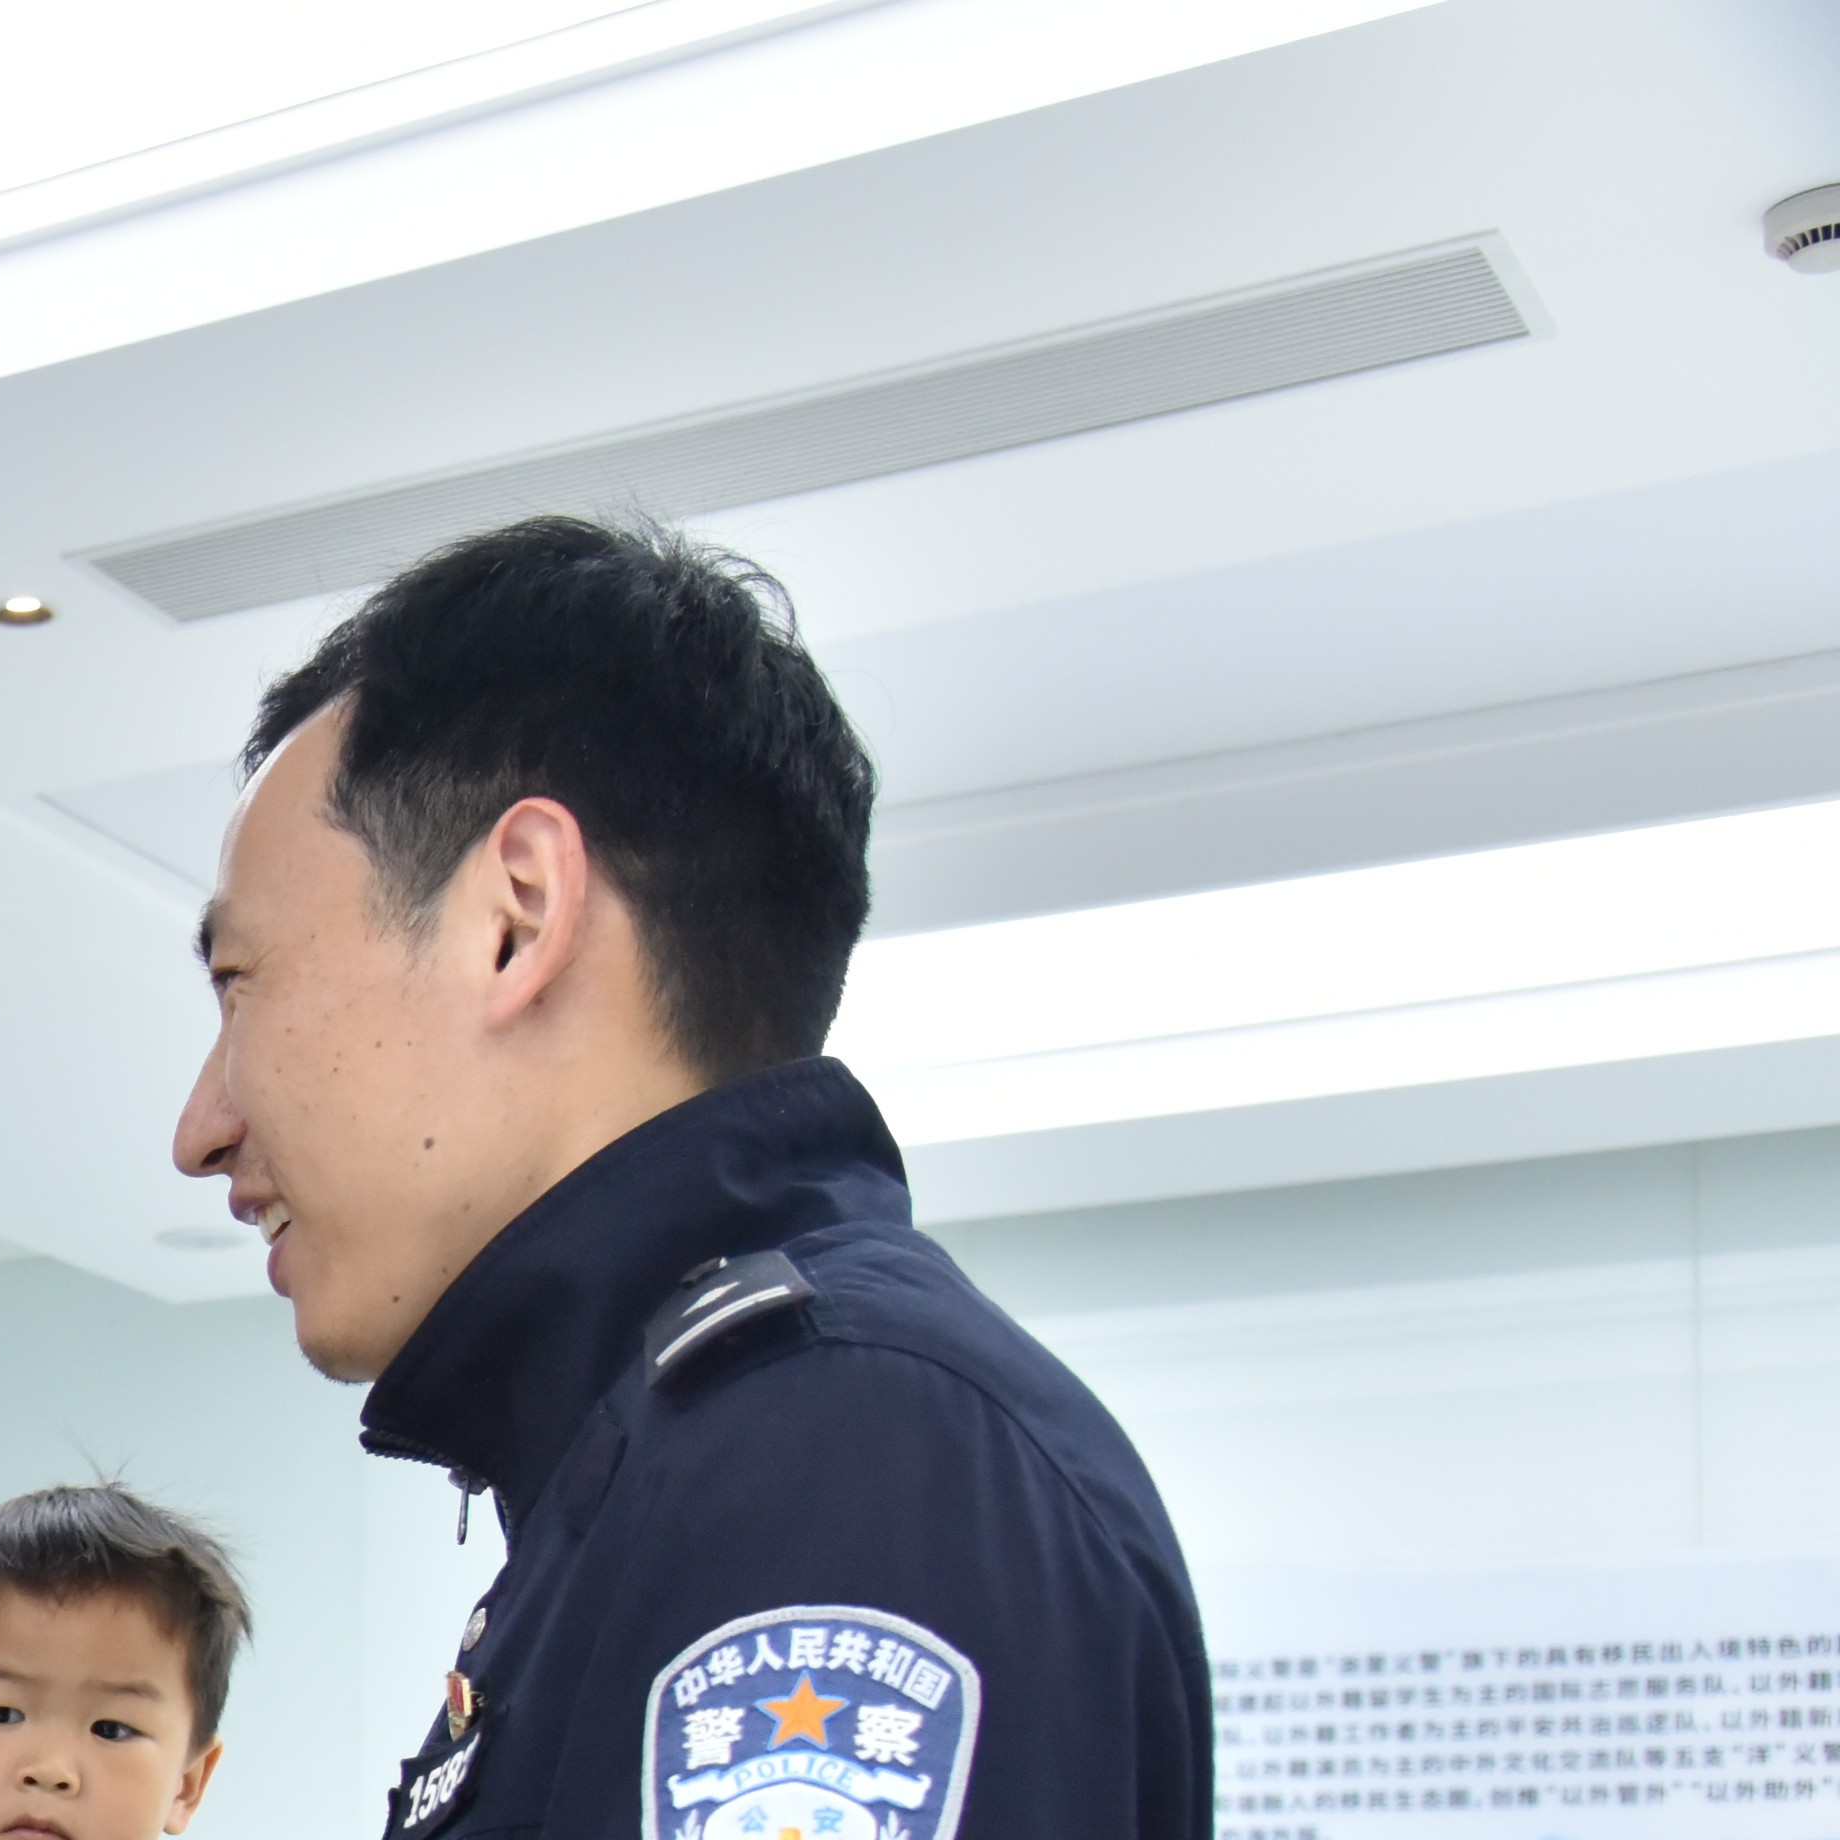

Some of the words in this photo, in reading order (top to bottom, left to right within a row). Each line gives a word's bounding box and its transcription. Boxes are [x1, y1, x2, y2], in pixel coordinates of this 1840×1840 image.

[673, 1627, 953, 1711] 中华人民共和国
[682, 1706, 746, 1769] 警
[853, 1704, 923, 1766] 察
[731, 1756, 860, 1791] POLICE
[737, 1805, 769, 1834] 公
[812, 1805, 845, 1835] 安
